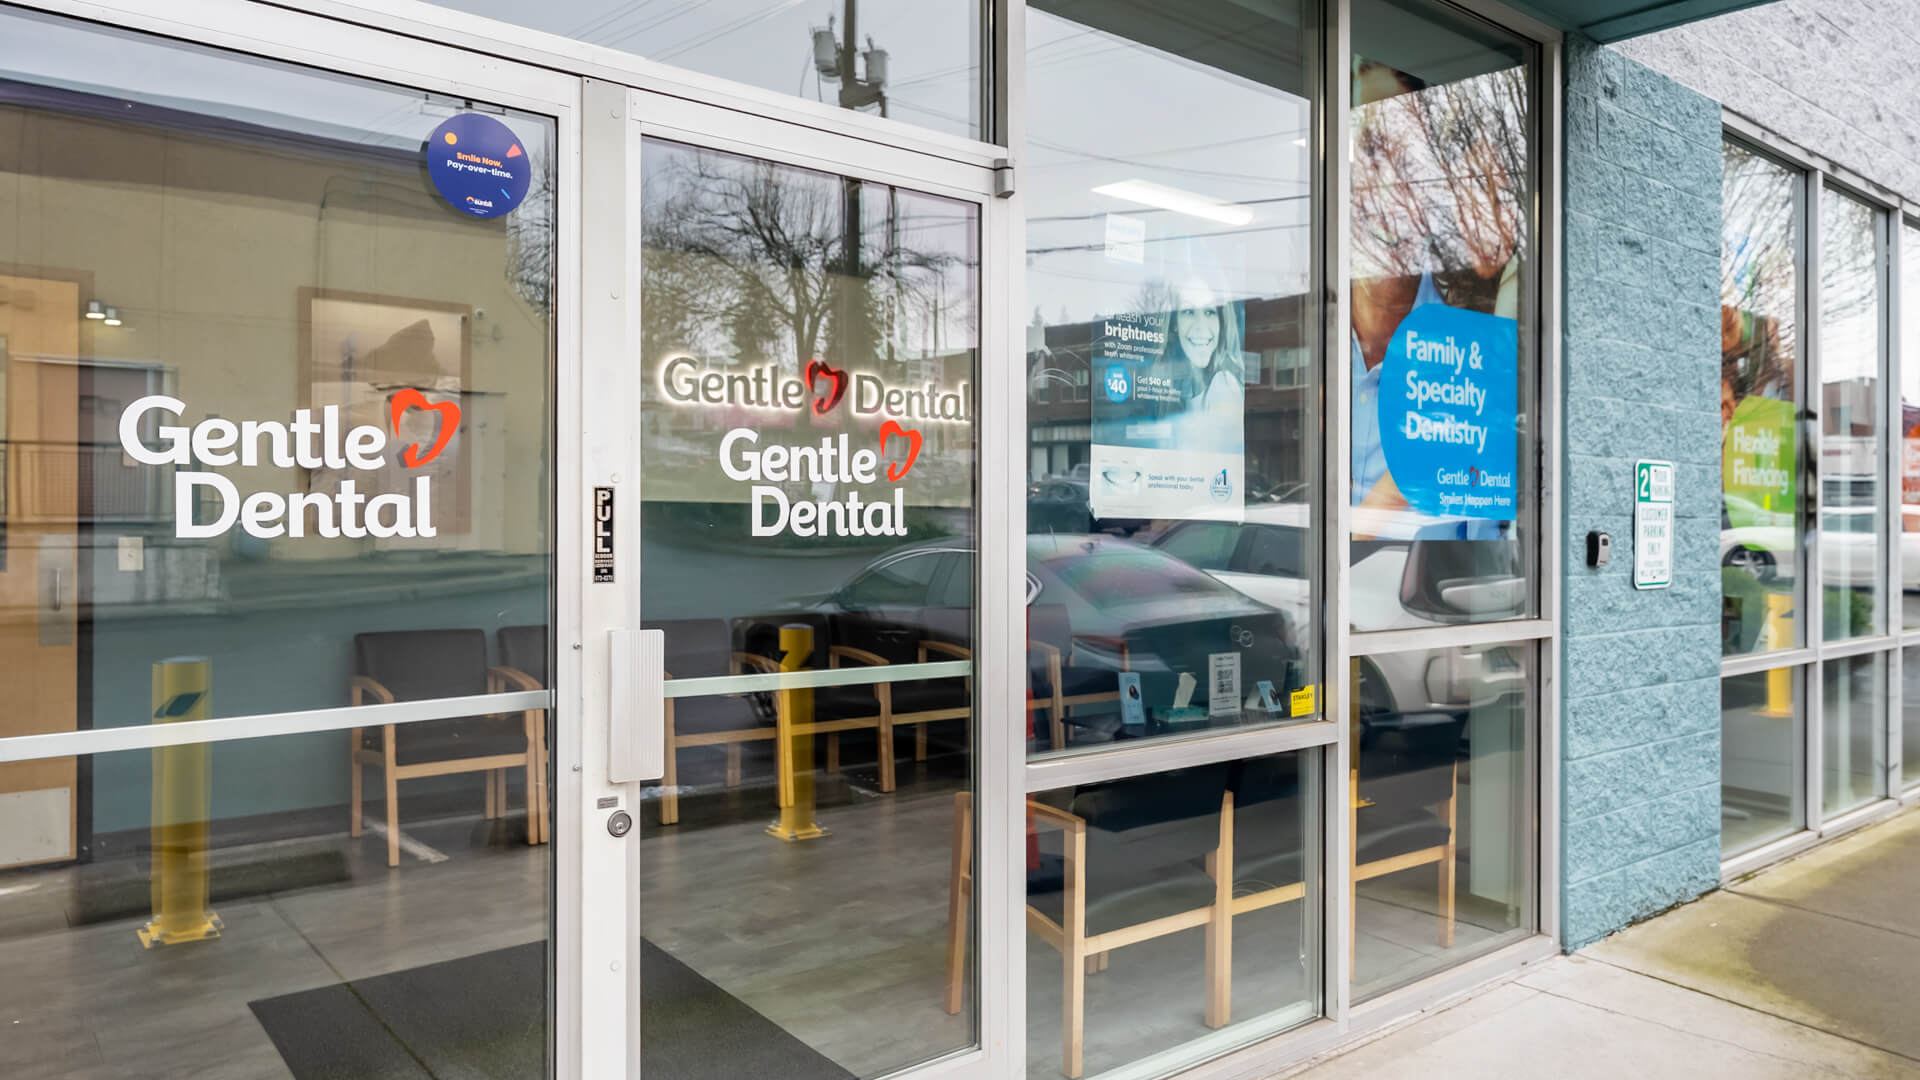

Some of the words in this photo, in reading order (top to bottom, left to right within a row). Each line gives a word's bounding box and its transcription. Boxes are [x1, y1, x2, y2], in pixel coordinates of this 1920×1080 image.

[447, 160, 513, 179] Pay-over-time.
[457, 152, 481, 164] Smile
[1104, 321, 1165, 344] brightness
[1406, 330, 1465, 375] Family
[1469, 341, 1484, 371] &
[662, 356, 804, 410] Gentle
[855, 373, 972, 422] Dental
[1107, 378, 1128, 395] $40
[1137, 375, 1148, 385] Get
[1148, 376, 1161, 387] $40
[1406, 370, 1487, 416] Specialty
[119, 394, 387, 470] Gentle
[1406, 411, 1488, 454] Dentistry
[1733, 426, 1779, 456] Flexible
[719, 428, 877, 484] Gentle
[1437, 468, 1470, 486] Gentle
[1480, 471, 1511, 488] Dental
[1640, 468, 1650, 498] 2
[1733, 458, 1789, 495] Financing
[176, 471, 437, 538] Dental
[751, 485, 907, 537] Dental
[1439, 492, 1464, 506] Smiles
[1465, 493, 1494, 508] Happen
[1494, 495, 1511, 506] Here
[597, 490, 611, 552] PULL
